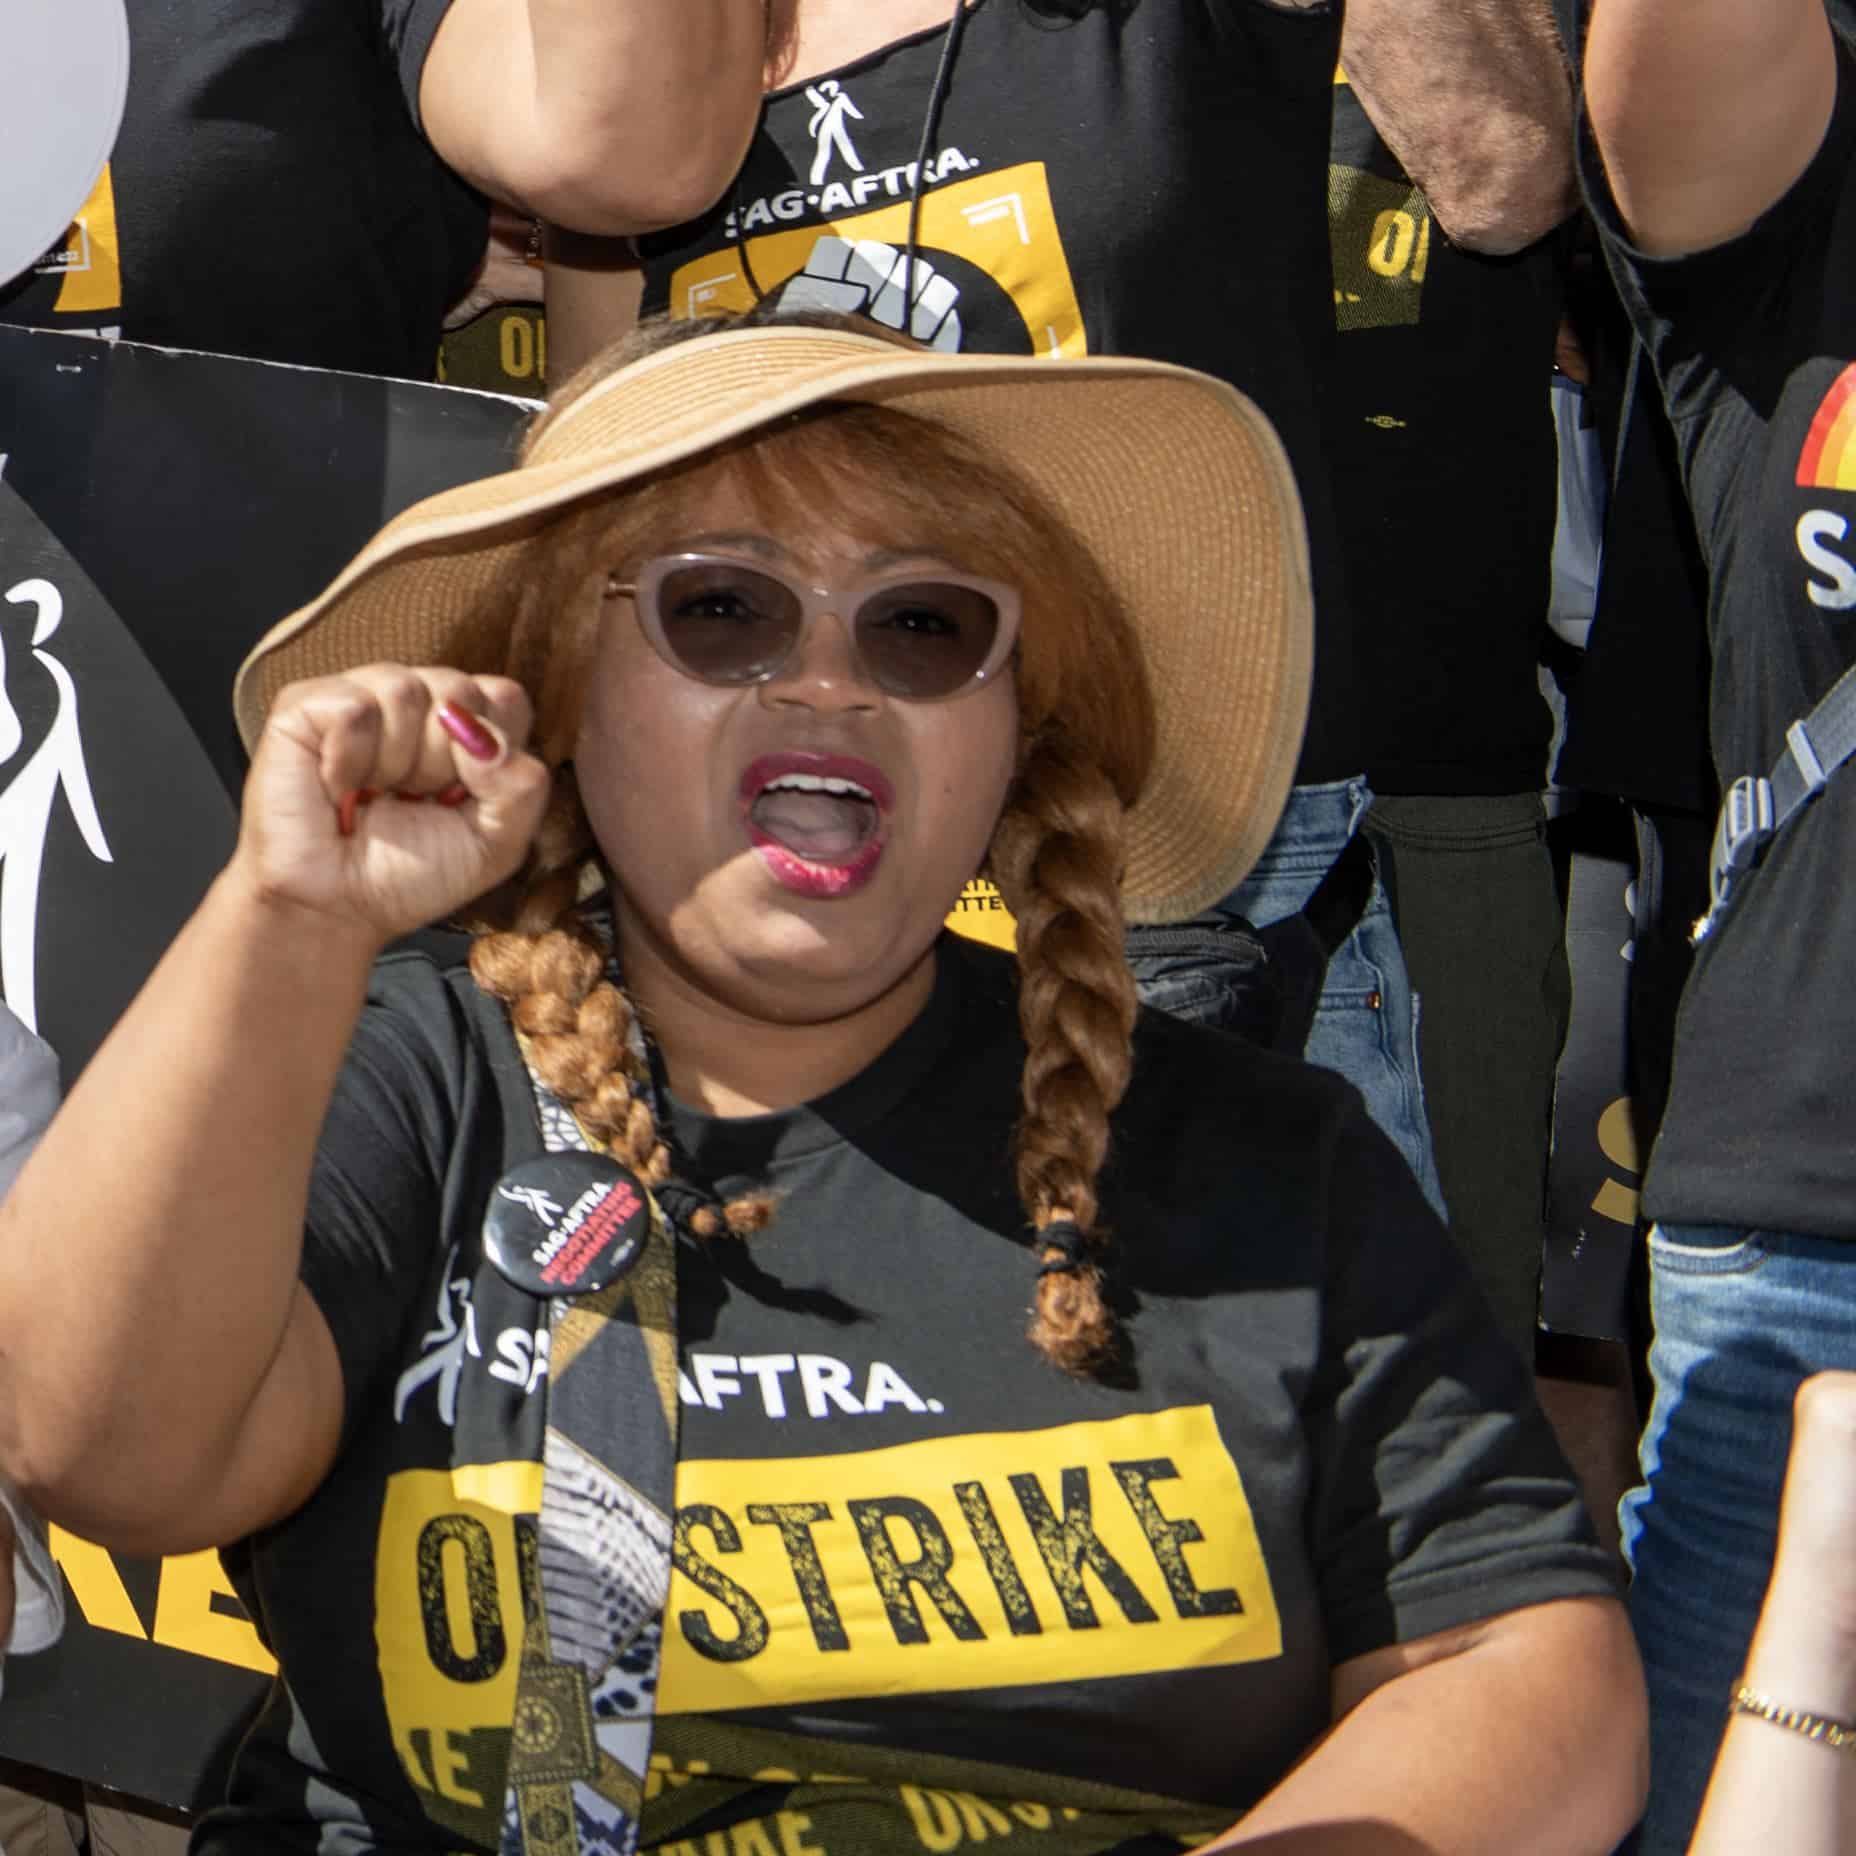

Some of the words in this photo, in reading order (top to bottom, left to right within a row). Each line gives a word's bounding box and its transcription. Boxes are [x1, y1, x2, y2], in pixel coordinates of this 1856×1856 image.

[540, 1181, 633, 1285] NEGOTIATING
[559, 1195, 642, 1286] COMMITTEE
[674, 1458, 1244, 1663] STRIKE
